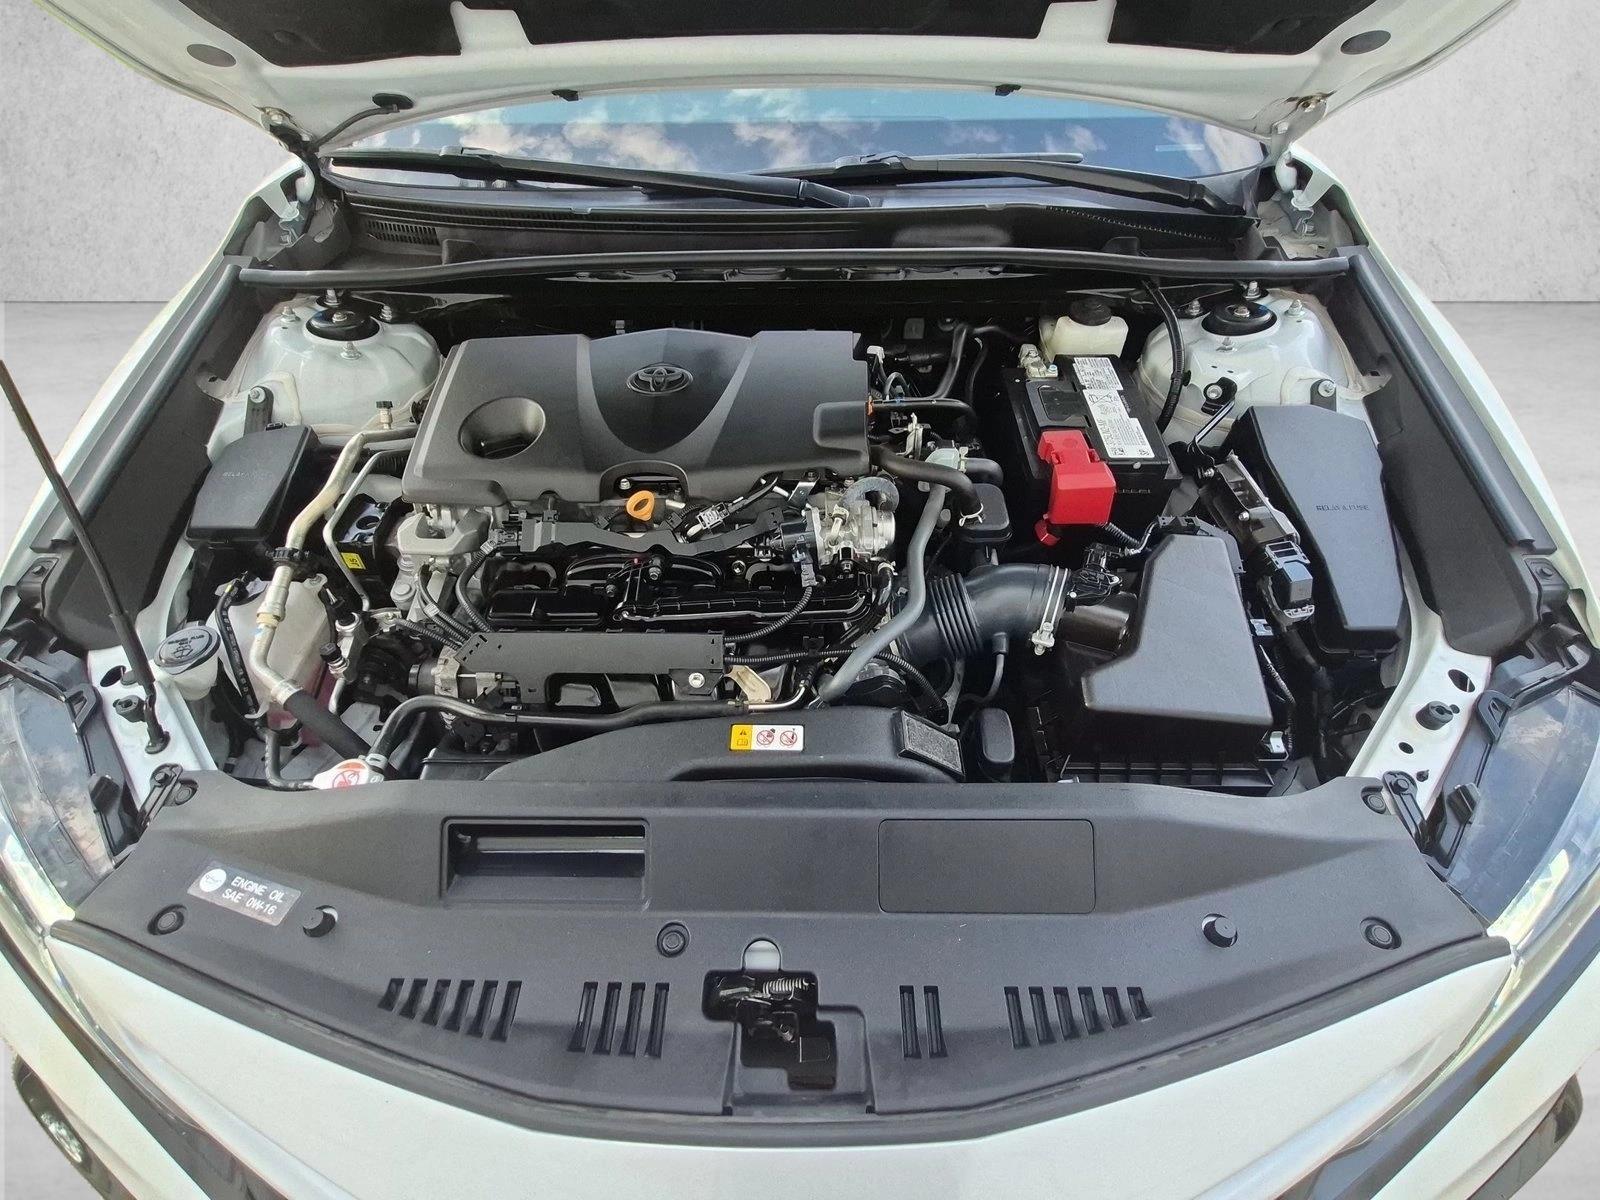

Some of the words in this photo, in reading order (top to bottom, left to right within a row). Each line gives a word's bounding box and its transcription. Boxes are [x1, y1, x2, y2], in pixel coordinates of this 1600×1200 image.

[222, 888, 244, 903] SAE
[245, 896, 278, 915] 0W-16
[230, 876, 268, 896] ENGINE
[269, 889, 286, 903] OIL
